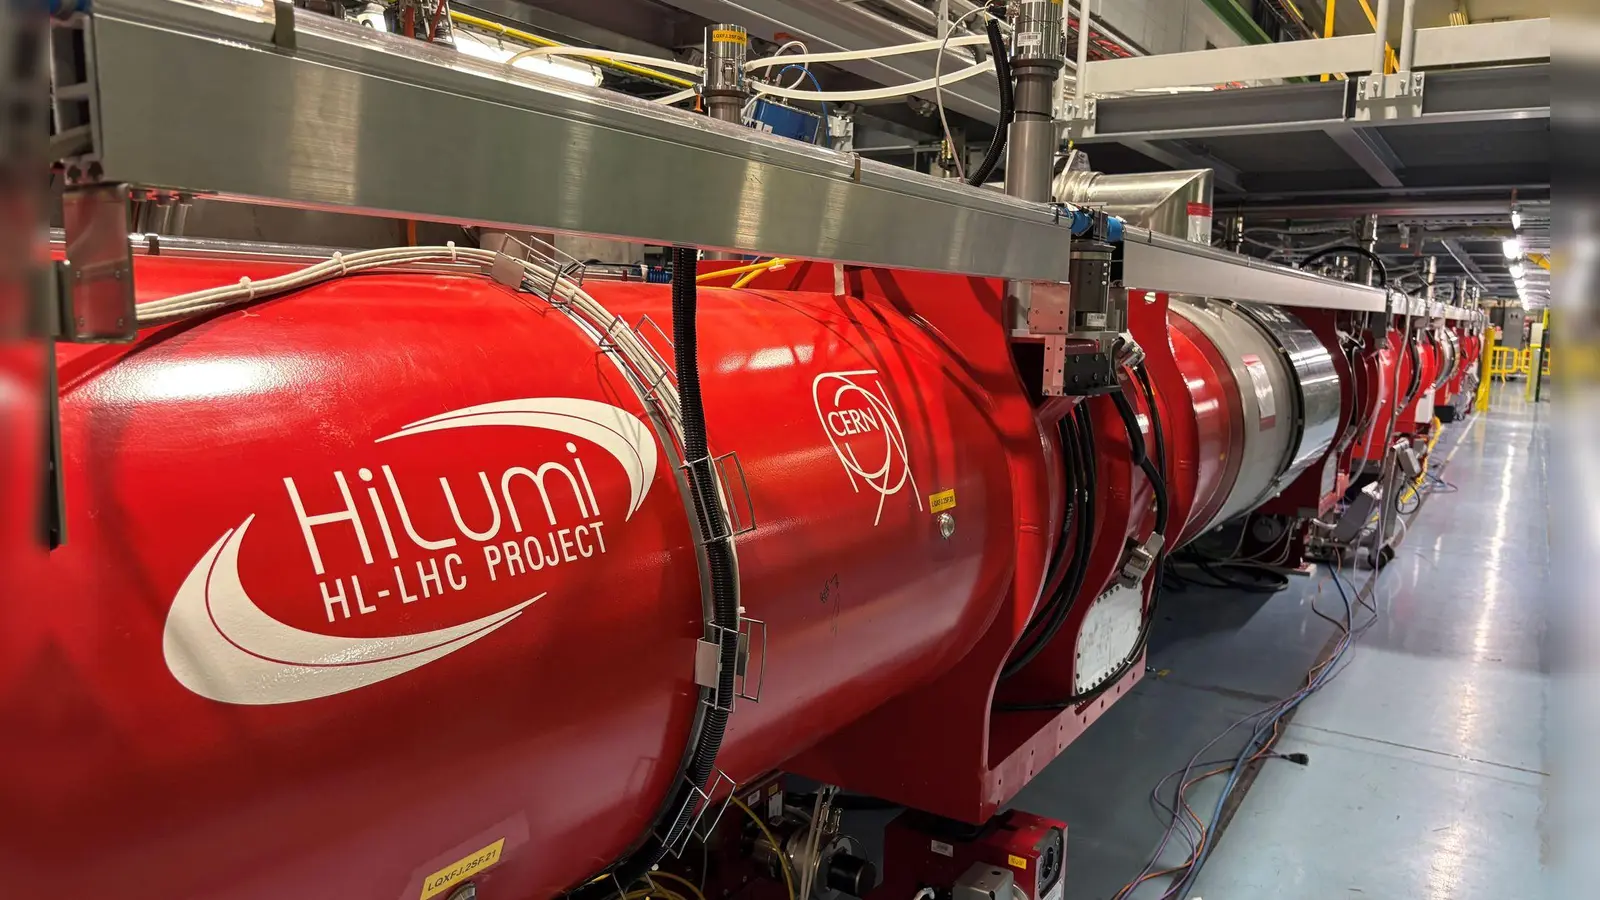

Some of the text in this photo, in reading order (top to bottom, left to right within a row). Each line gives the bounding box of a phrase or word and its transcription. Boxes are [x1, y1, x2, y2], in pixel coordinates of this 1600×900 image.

[827, 407, 880, 437] CERN
[284, 441, 601, 575] HiLumi
[319, 521, 608, 623] HL-LHC PROJECT
[427, 849, 497, 892] LQXFJ.2SF.21
